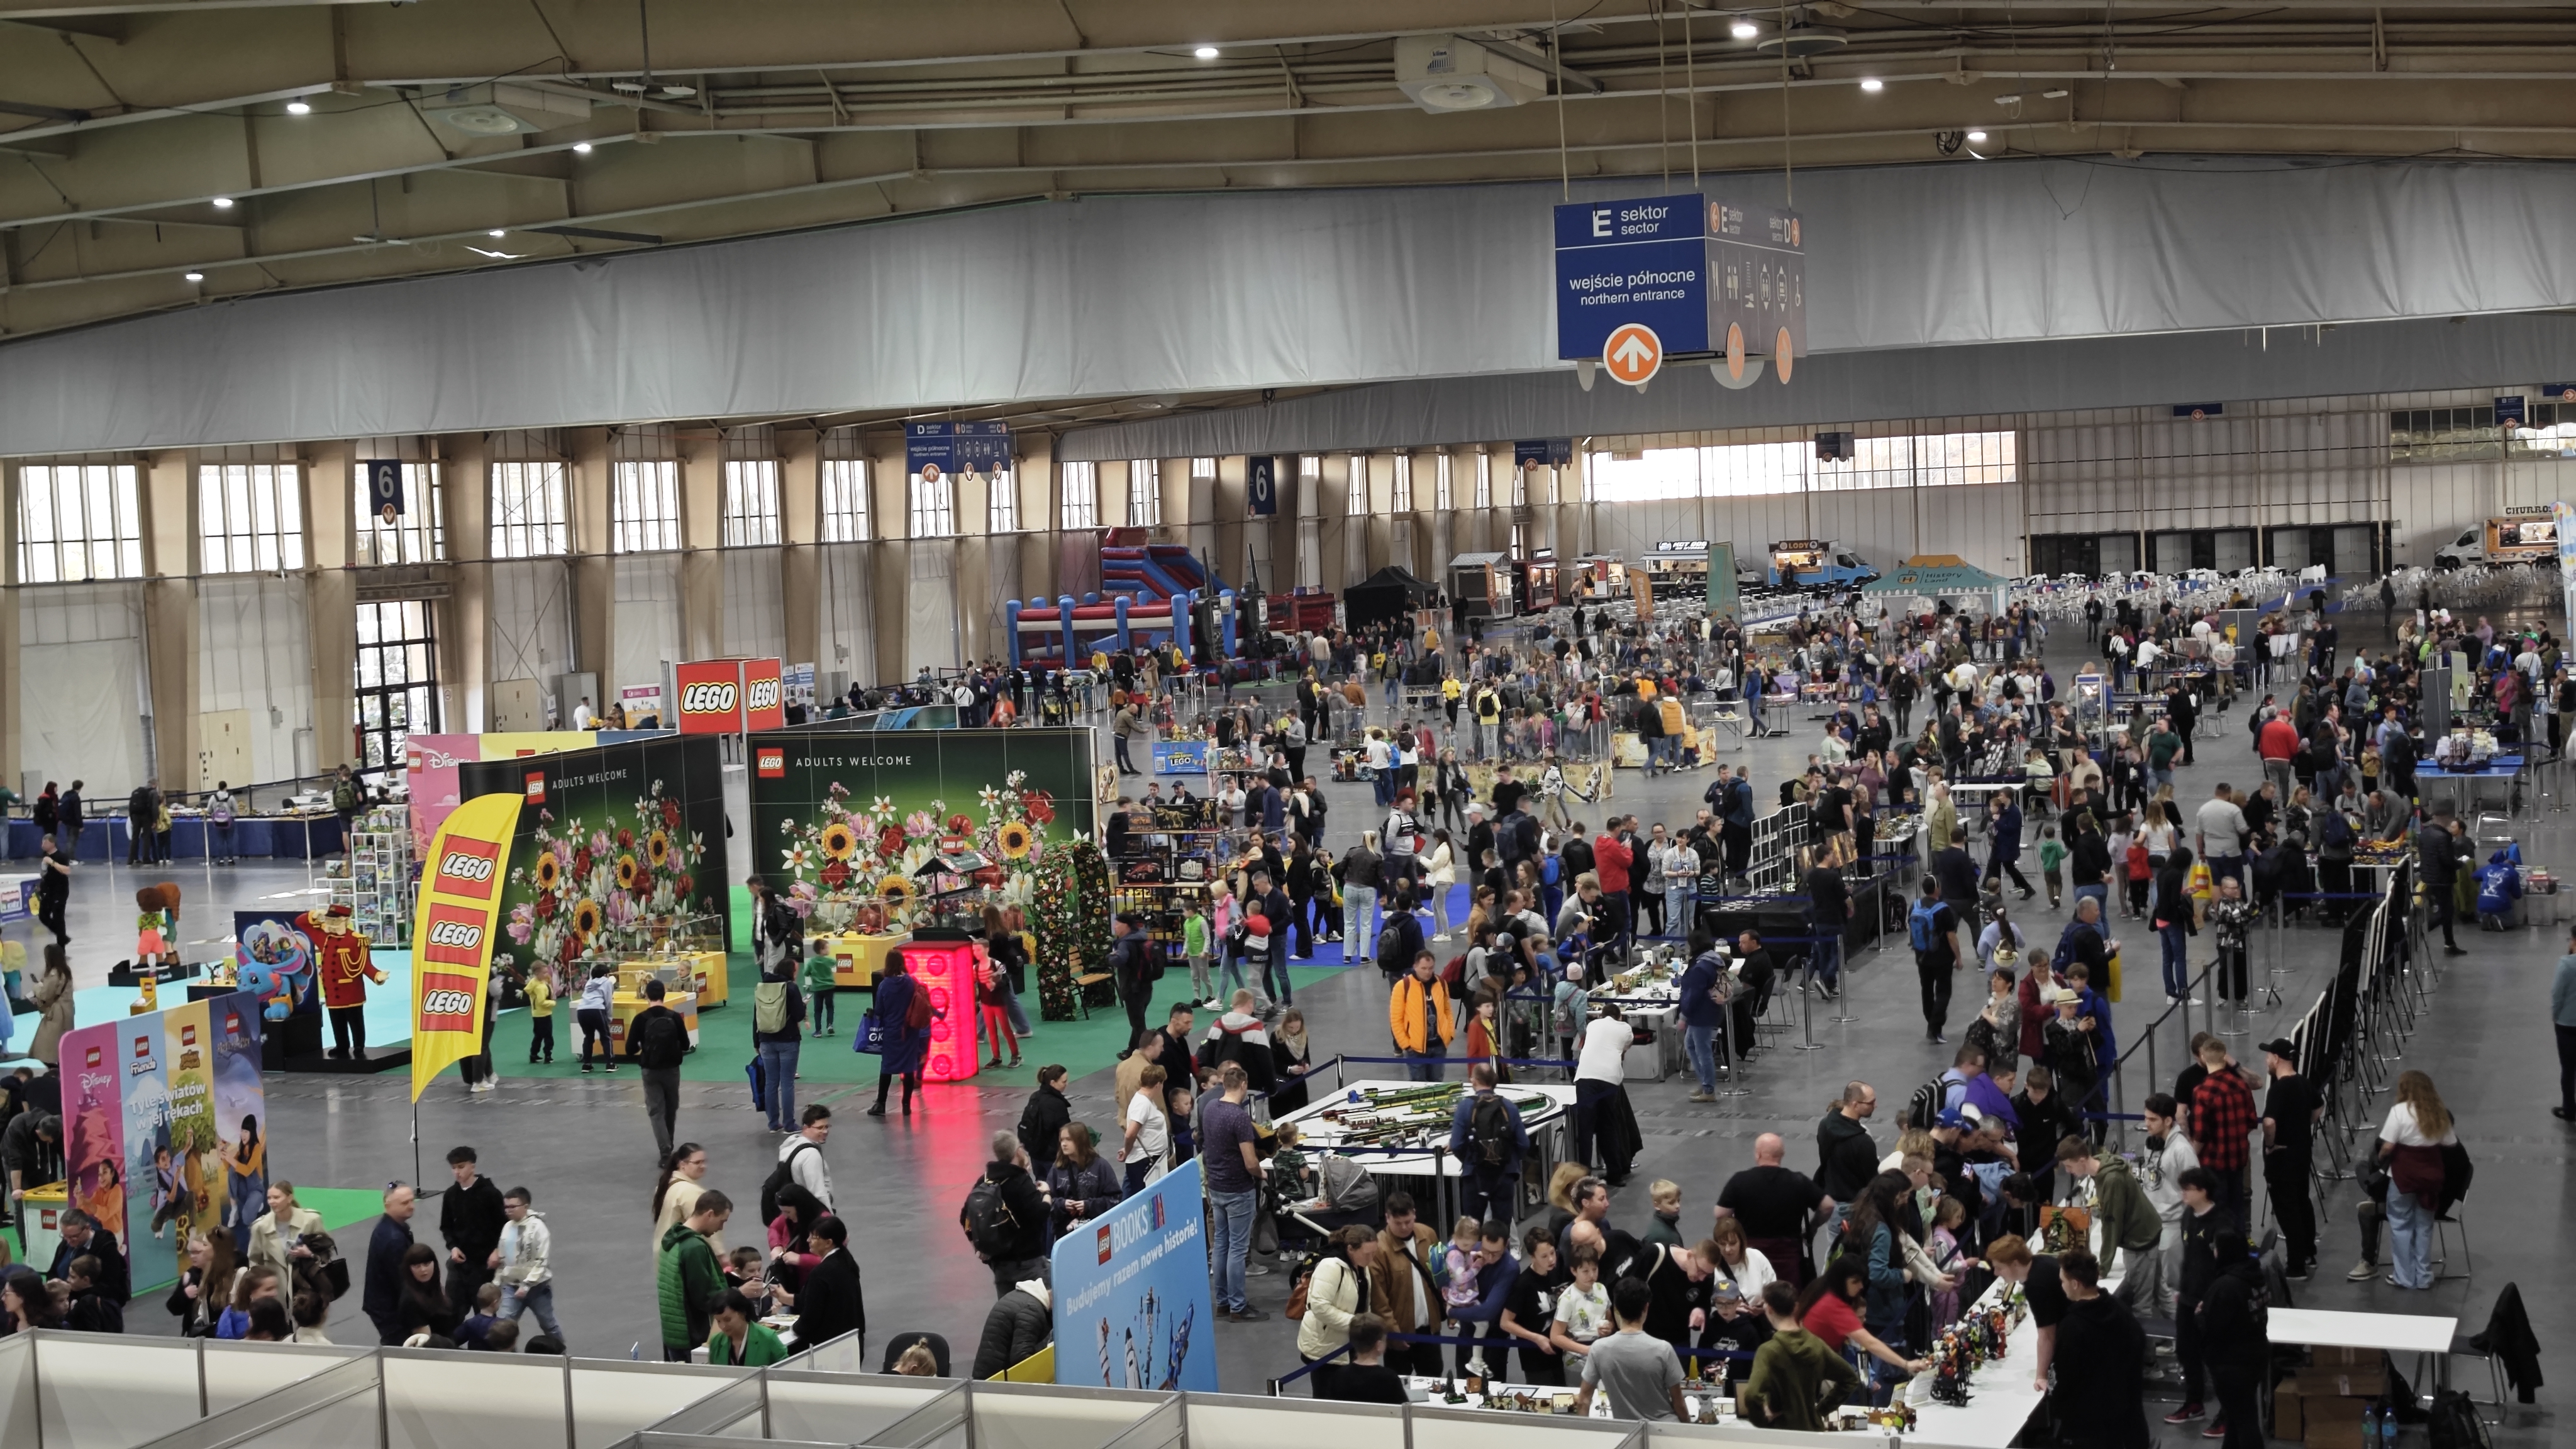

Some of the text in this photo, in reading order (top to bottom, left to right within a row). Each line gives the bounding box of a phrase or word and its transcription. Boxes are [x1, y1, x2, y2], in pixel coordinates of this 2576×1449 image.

[1593, 209, 1613, 237] E
[1621, 205, 1668, 222] sektor
[1721, 206, 1728, 233] E
[1621, 222, 1660, 235] sector
[1784, 218, 1790, 243] D
[1569, 269, 1696, 291] wejście północne
[1580, 288, 1685, 306] northern entrance
[917, 425, 924, 435] D
[378, 465, 394, 499] 6
[1255, 465, 1267, 502] 6
[683, 684, 736, 711] LEGO
[748, 680, 779, 709] LEGO
[759, 755, 913, 769] LEGO ADULTS WELCOME
[1170, 757, 1191, 767] LEGO
[527, 768, 628, 796] LEGO ADULTS WELCOME
[441, 853, 493, 881] LEGO
[431, 921, 482, 948] LEGO
[424, 990, 472, 1015] LEGO
[182, 1030, 195, 1040] LEGO
[609, 1025, 623, 1033] EGO
[87, 1053, 100, 1063] LEGO
[136, 1043, 148, 1053] LEGO
[130, 1057, 157, 1075] Friends
[78, 1072, 112, 1089] Disney
[130, 1080, 206, 1116] Tyle światów
[136, 1101, 203, 1131] w jej rękach
[1099, 1204, 1148, 1253] LEGO BOOKS
[1067, 1216, 1198, 1316] Budujemy razem nowe historie!
